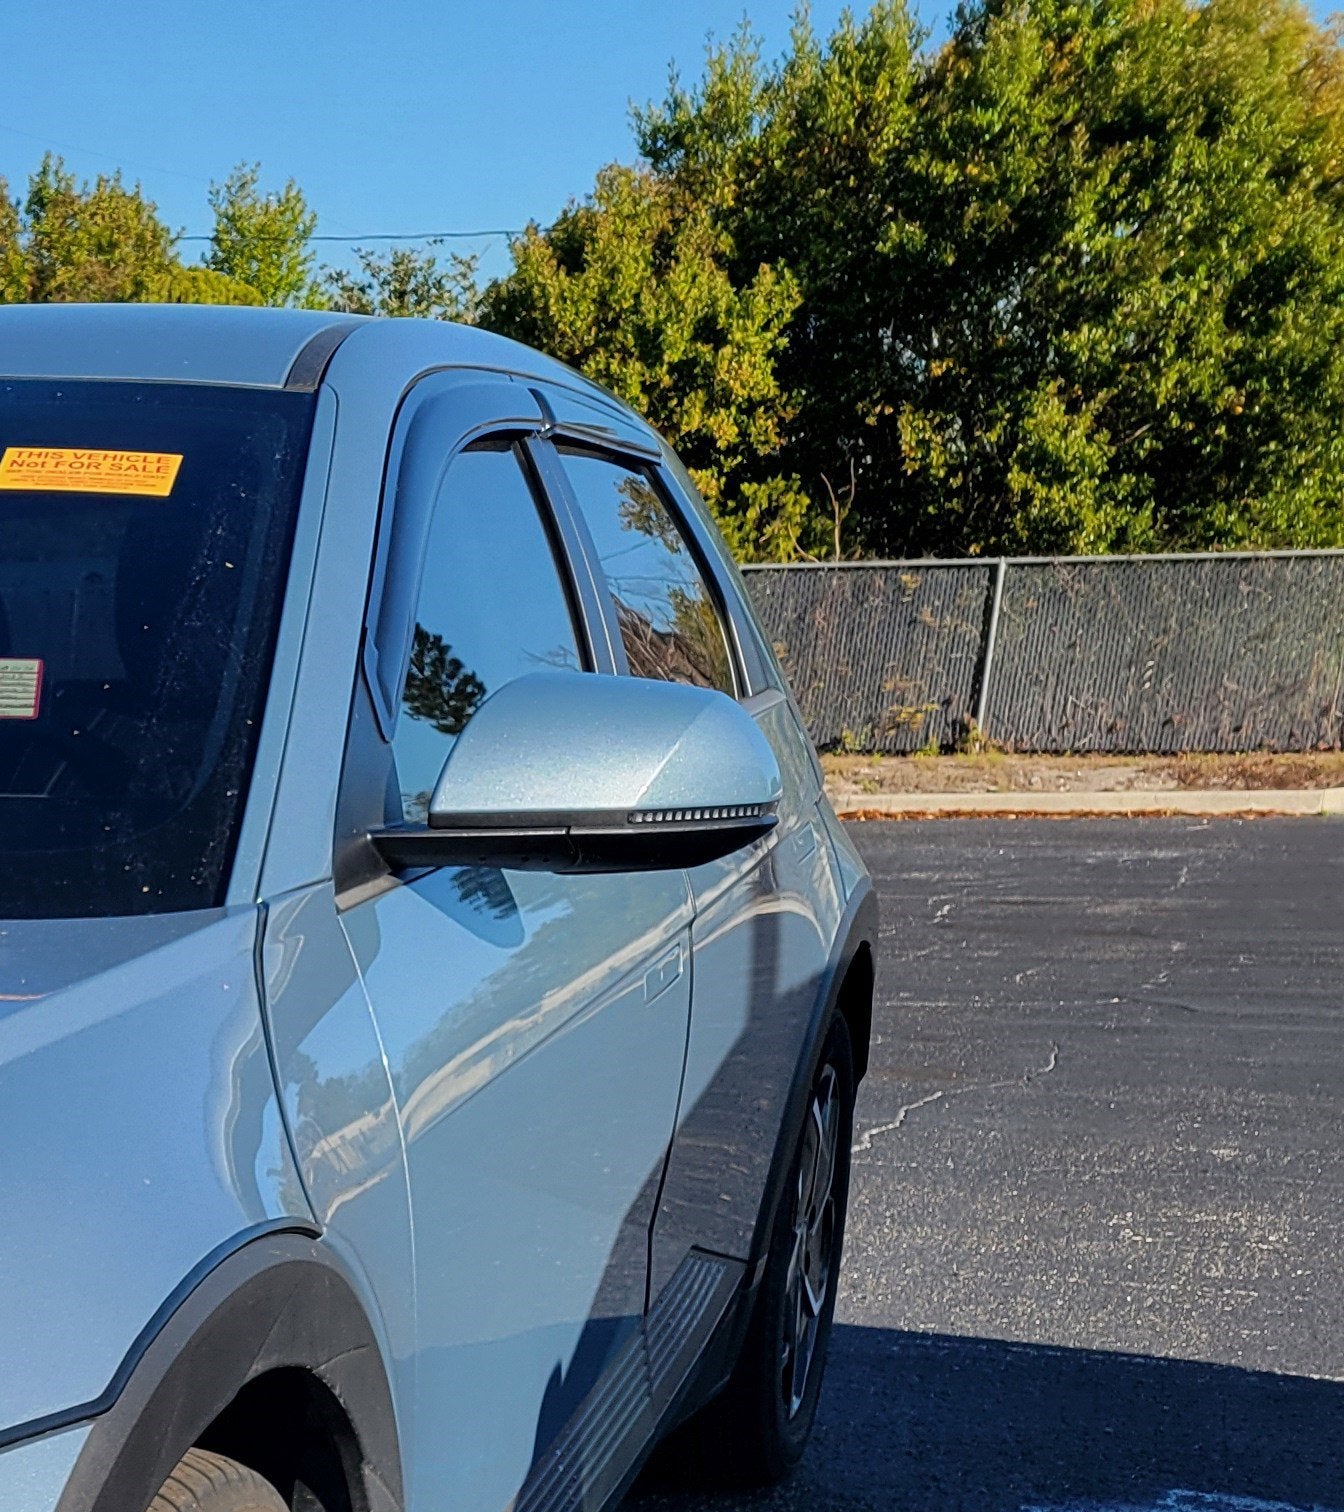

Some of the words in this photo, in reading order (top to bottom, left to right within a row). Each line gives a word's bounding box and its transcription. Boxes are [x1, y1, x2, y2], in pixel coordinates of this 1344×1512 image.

[15, 450, 64, 460] THIS
[73, 452, 172, 464] VEHICLE
[9, 459, 48, 468] Not
[54, 461, 102, 470] FOR
[109, 463, 171, 474] SALE
